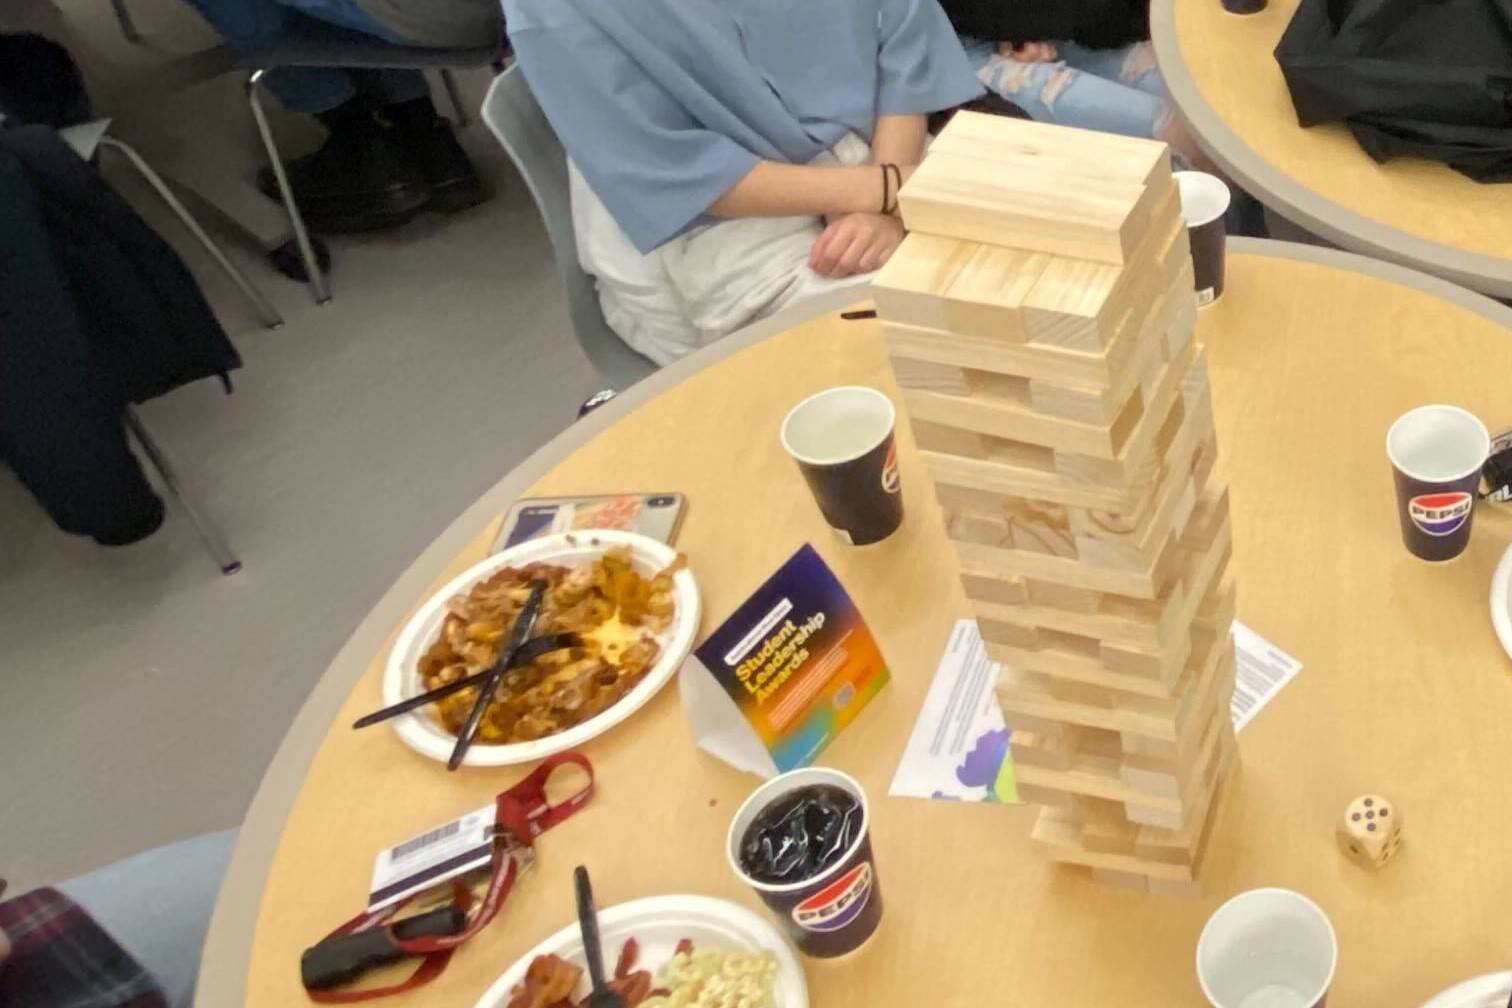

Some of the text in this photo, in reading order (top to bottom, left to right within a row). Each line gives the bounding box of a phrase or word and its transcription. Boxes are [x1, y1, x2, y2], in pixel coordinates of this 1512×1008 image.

[1411, 499, 1470, 520] PEPSI
[736, 620, 797, 681] Student
[745, 612, 826, 693] Leadership
[756, 648, 809, 704] Awards
[798, 869, 869, 922] PEPSI
